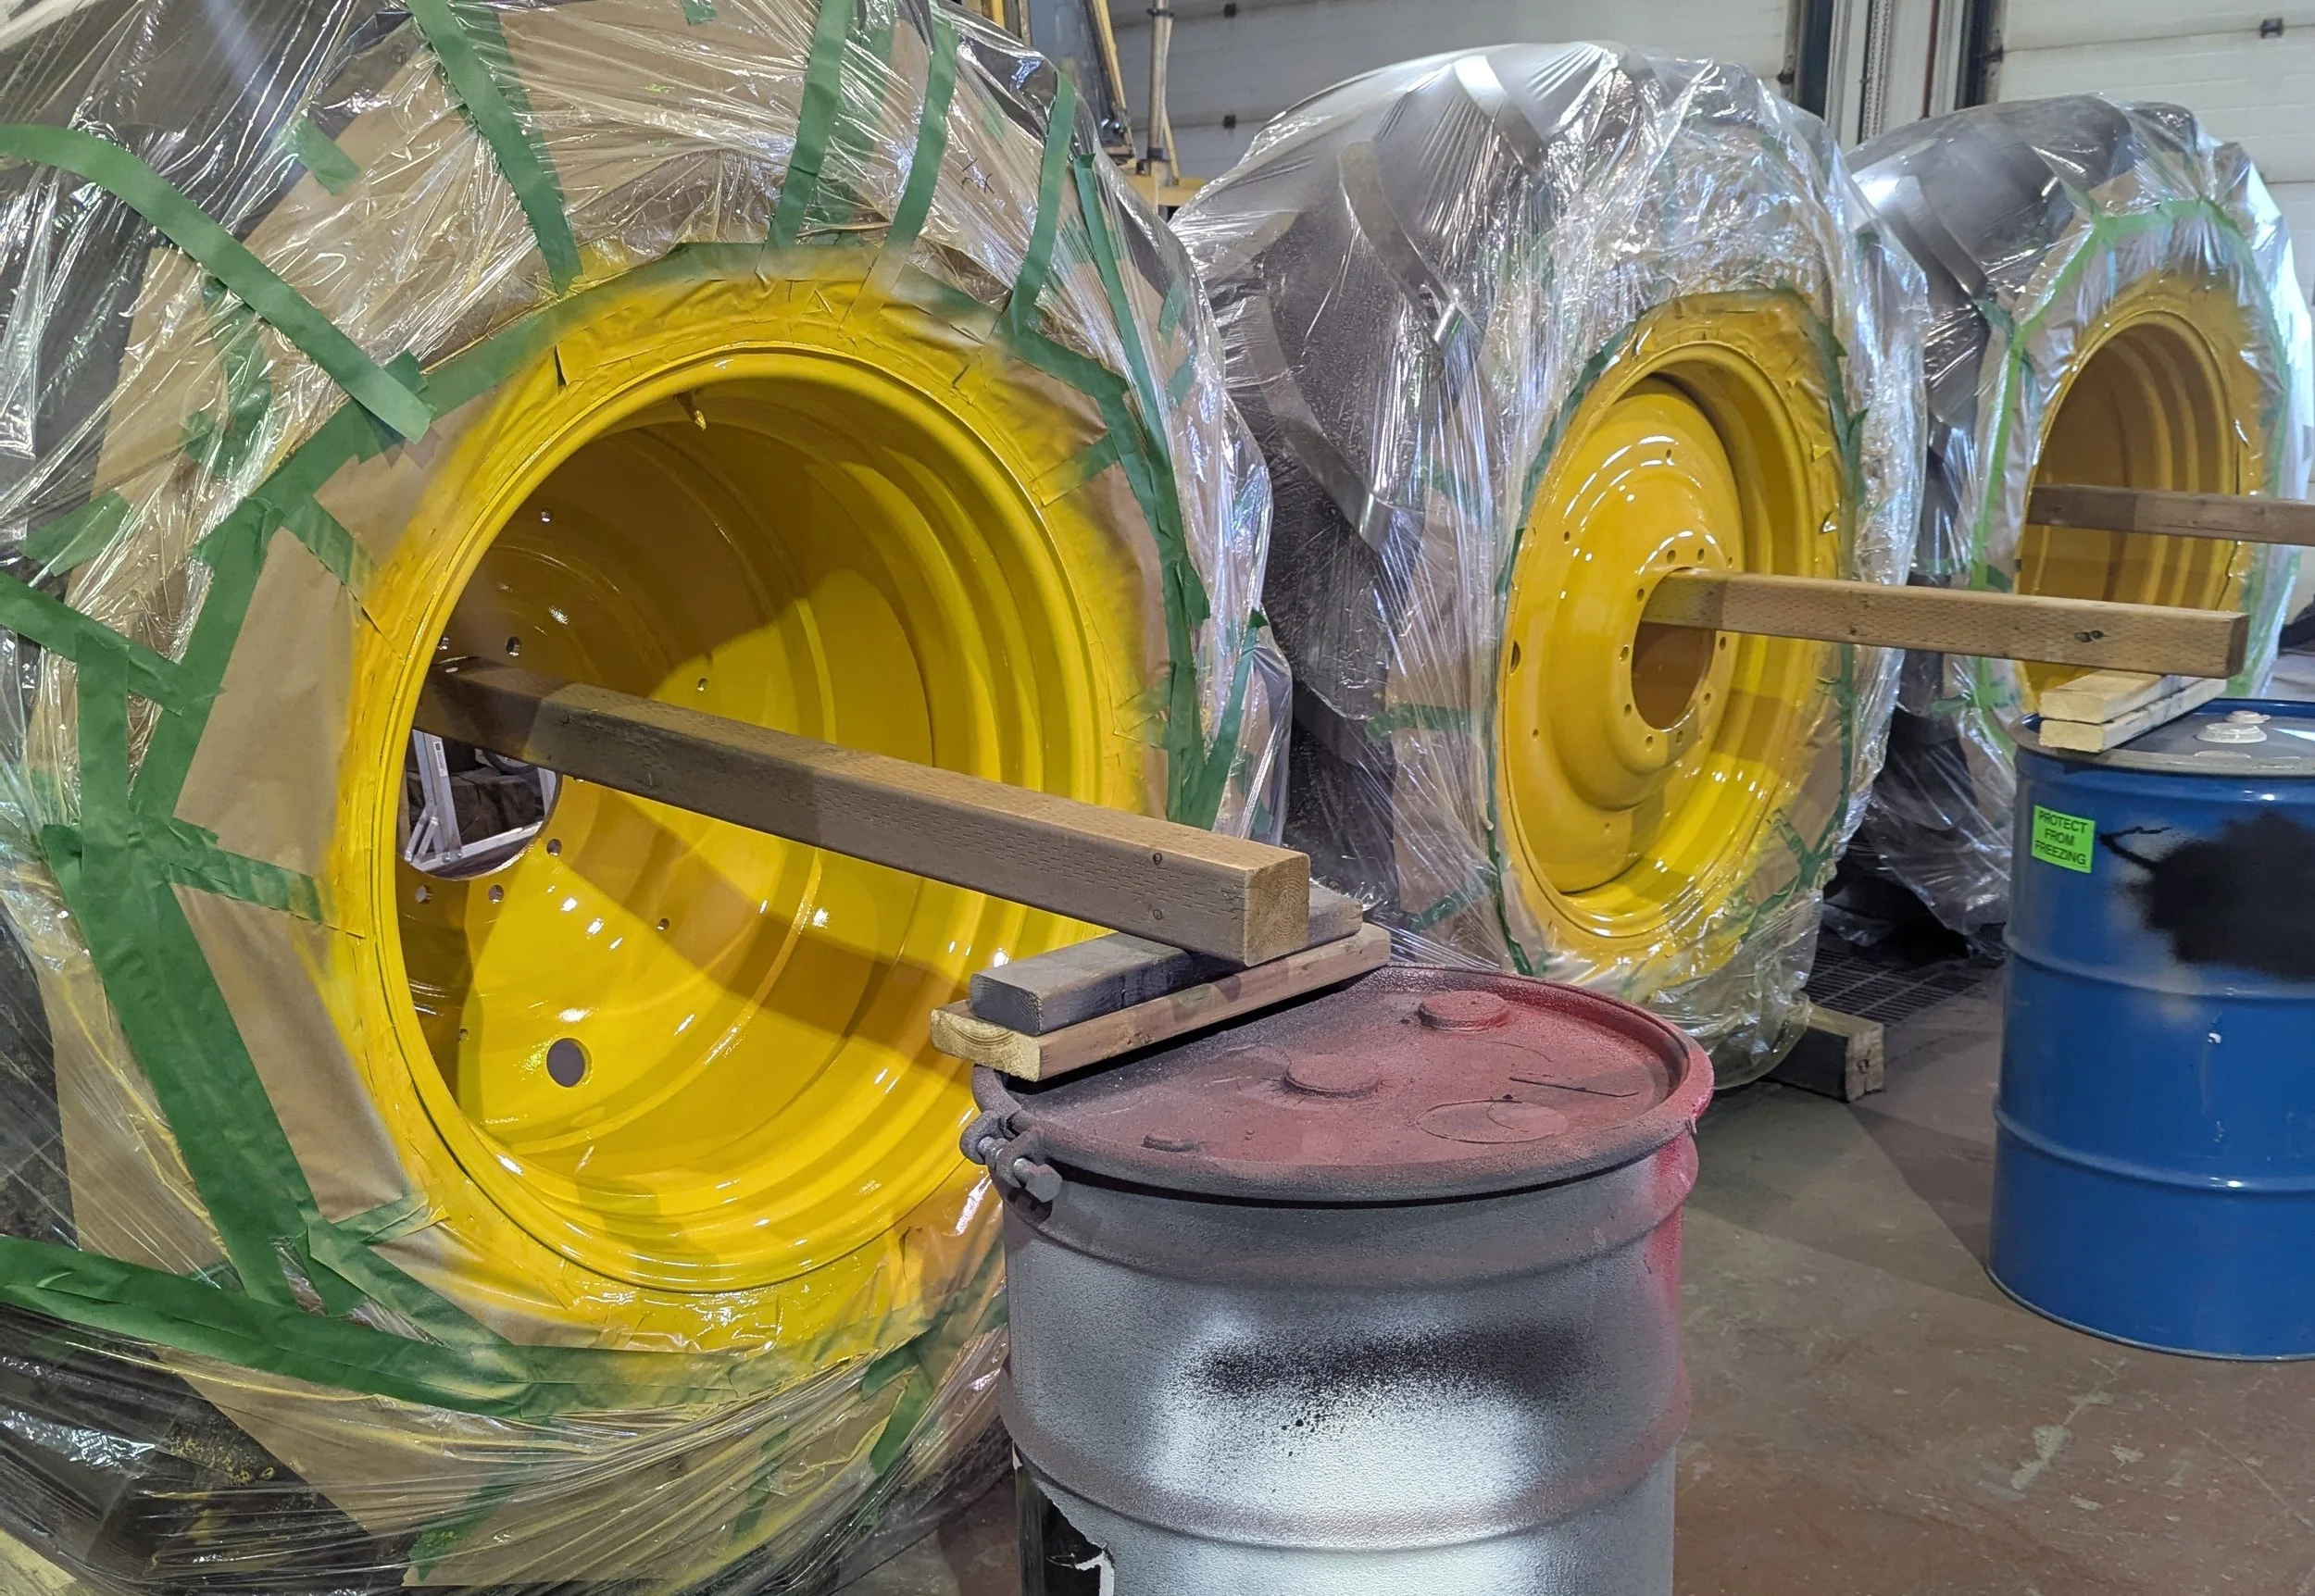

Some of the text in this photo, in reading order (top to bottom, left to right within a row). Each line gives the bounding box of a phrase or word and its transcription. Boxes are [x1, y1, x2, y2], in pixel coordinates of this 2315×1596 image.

[2039, 811, 2088, 833] PROTECT
[2045, 829, 2075, 846] FROM
[2035, 840, 2086, 865] FREEZING
